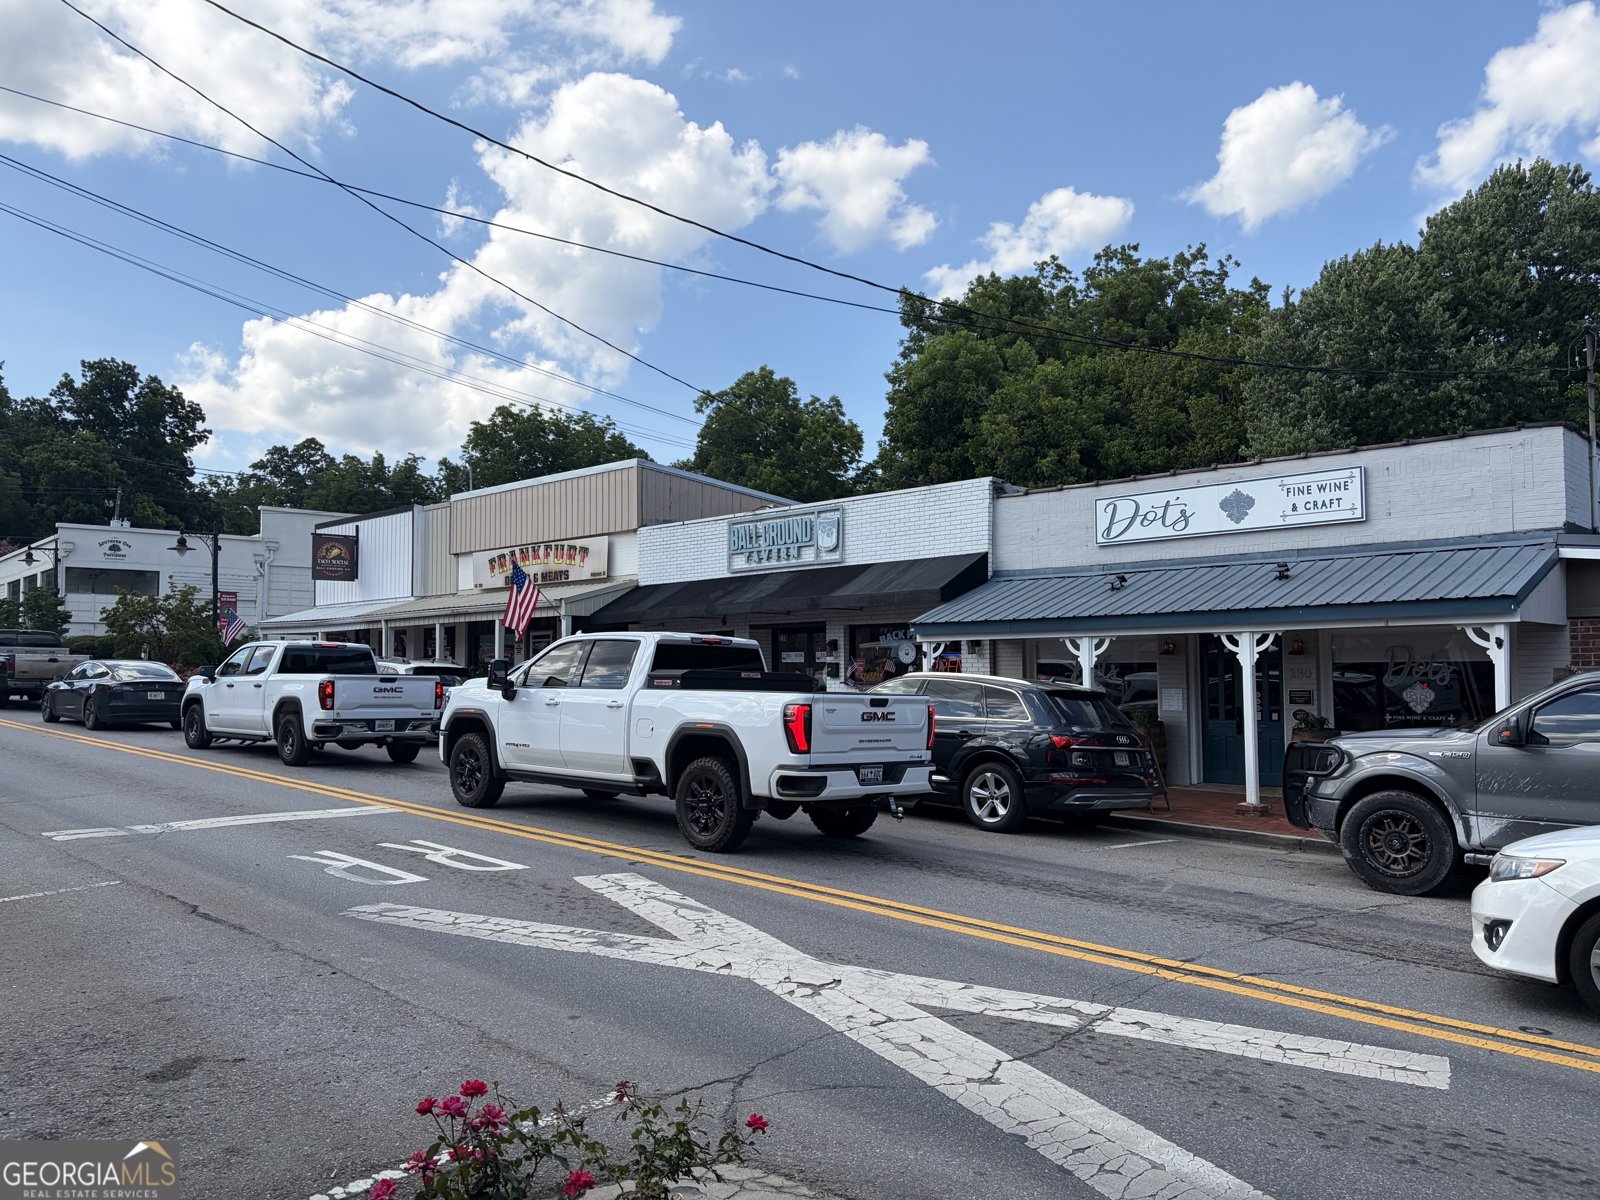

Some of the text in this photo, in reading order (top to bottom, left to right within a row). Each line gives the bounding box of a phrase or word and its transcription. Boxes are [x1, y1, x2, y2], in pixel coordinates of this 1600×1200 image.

[1285, 480, 1350, 498] FINE WINE
[1291, 498, 1343, 512] & CRAFT
[1101, 497, 1196, 540] Dot's
[730, 517, 812, 551] BALL GROUND
[488, 544, 590, 578] FRANKFURT
[744, 545, 799, 563] TAVERN
[533, 572, 539, 583] &
[541, 569, 570, 583] MEATS
[373, 686, 404, 694] GMC
[861, 711, 896, 722] GMC
